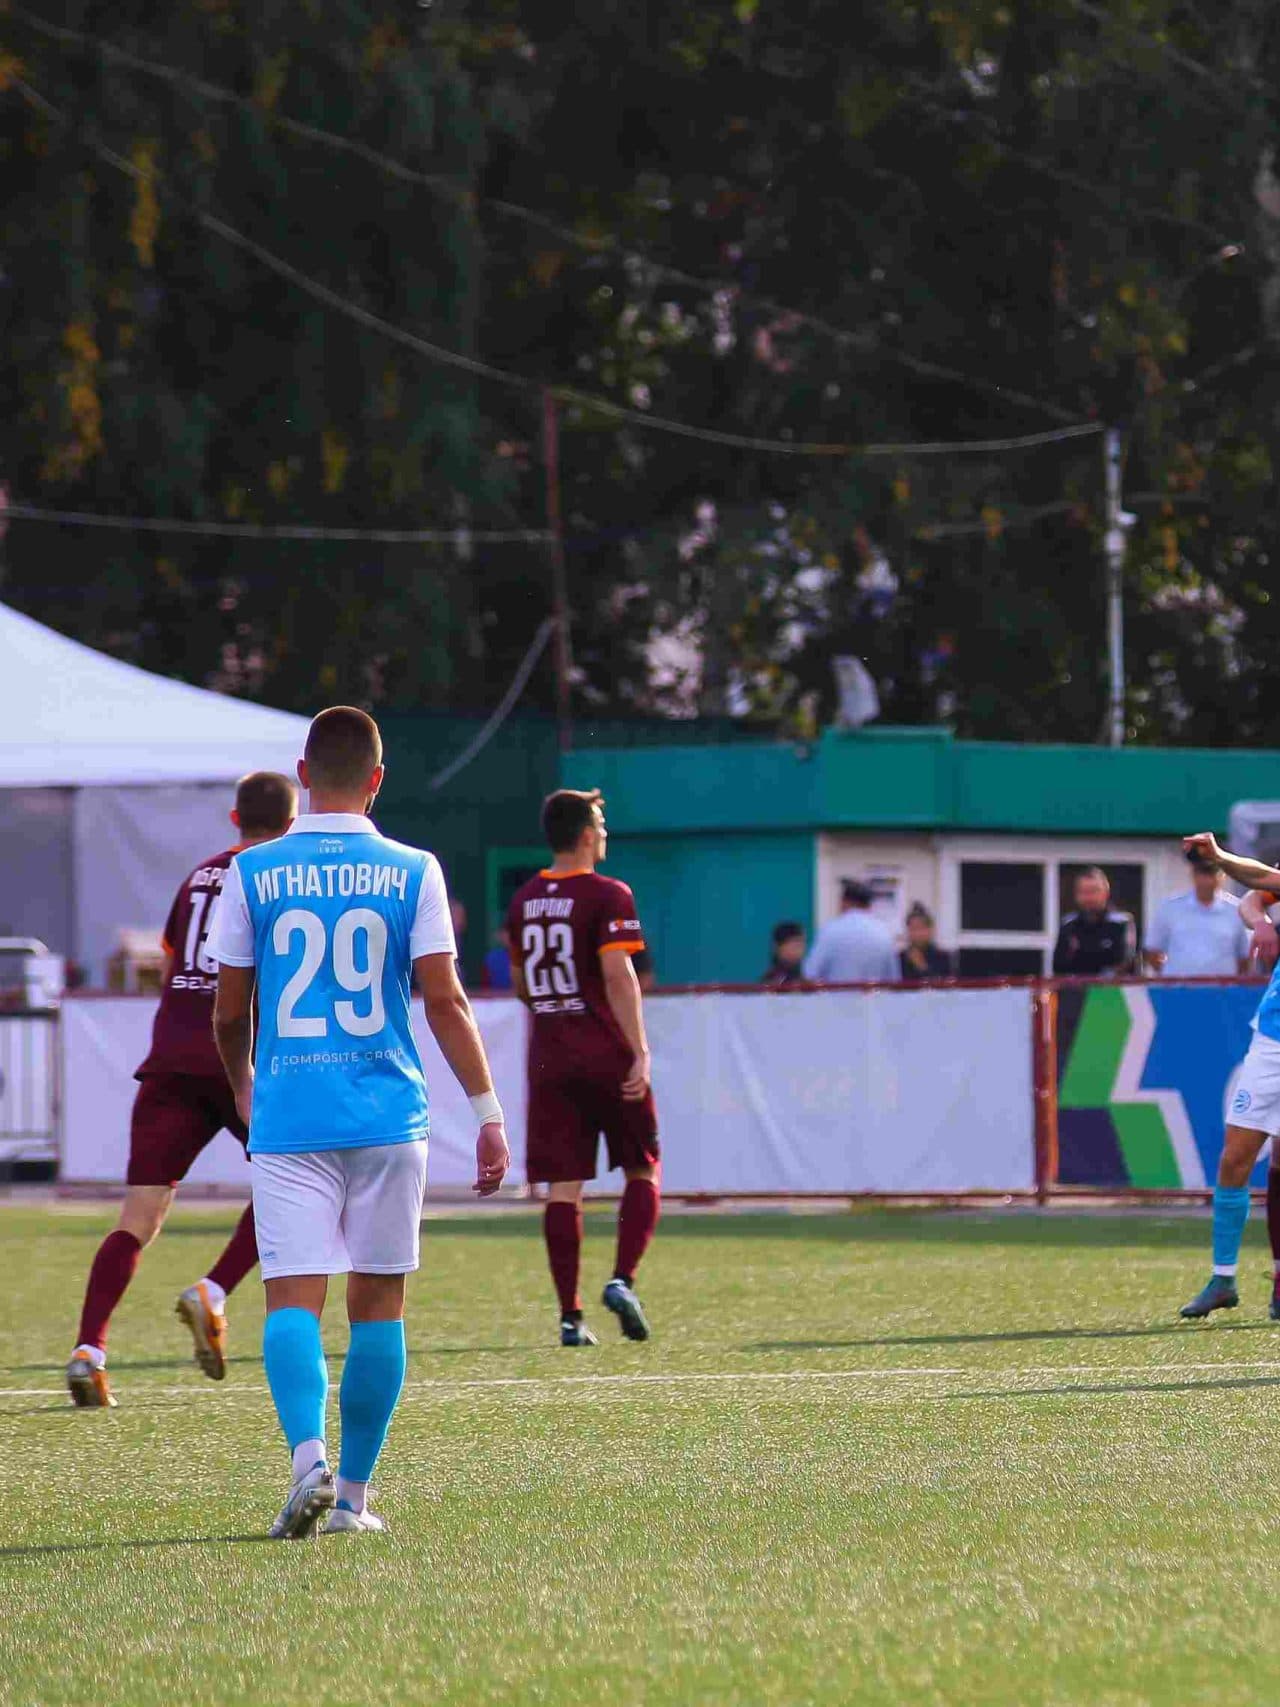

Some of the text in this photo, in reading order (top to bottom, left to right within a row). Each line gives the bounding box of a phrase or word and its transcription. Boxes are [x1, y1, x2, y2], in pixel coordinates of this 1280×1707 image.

[253, 863, 408, 905] ИГНАТОВИЧ
[272, 907, 389, 1038] 29
[523, 922, 579, 997] 23
[282, 1052, 360, 1066] COMPOSITE
